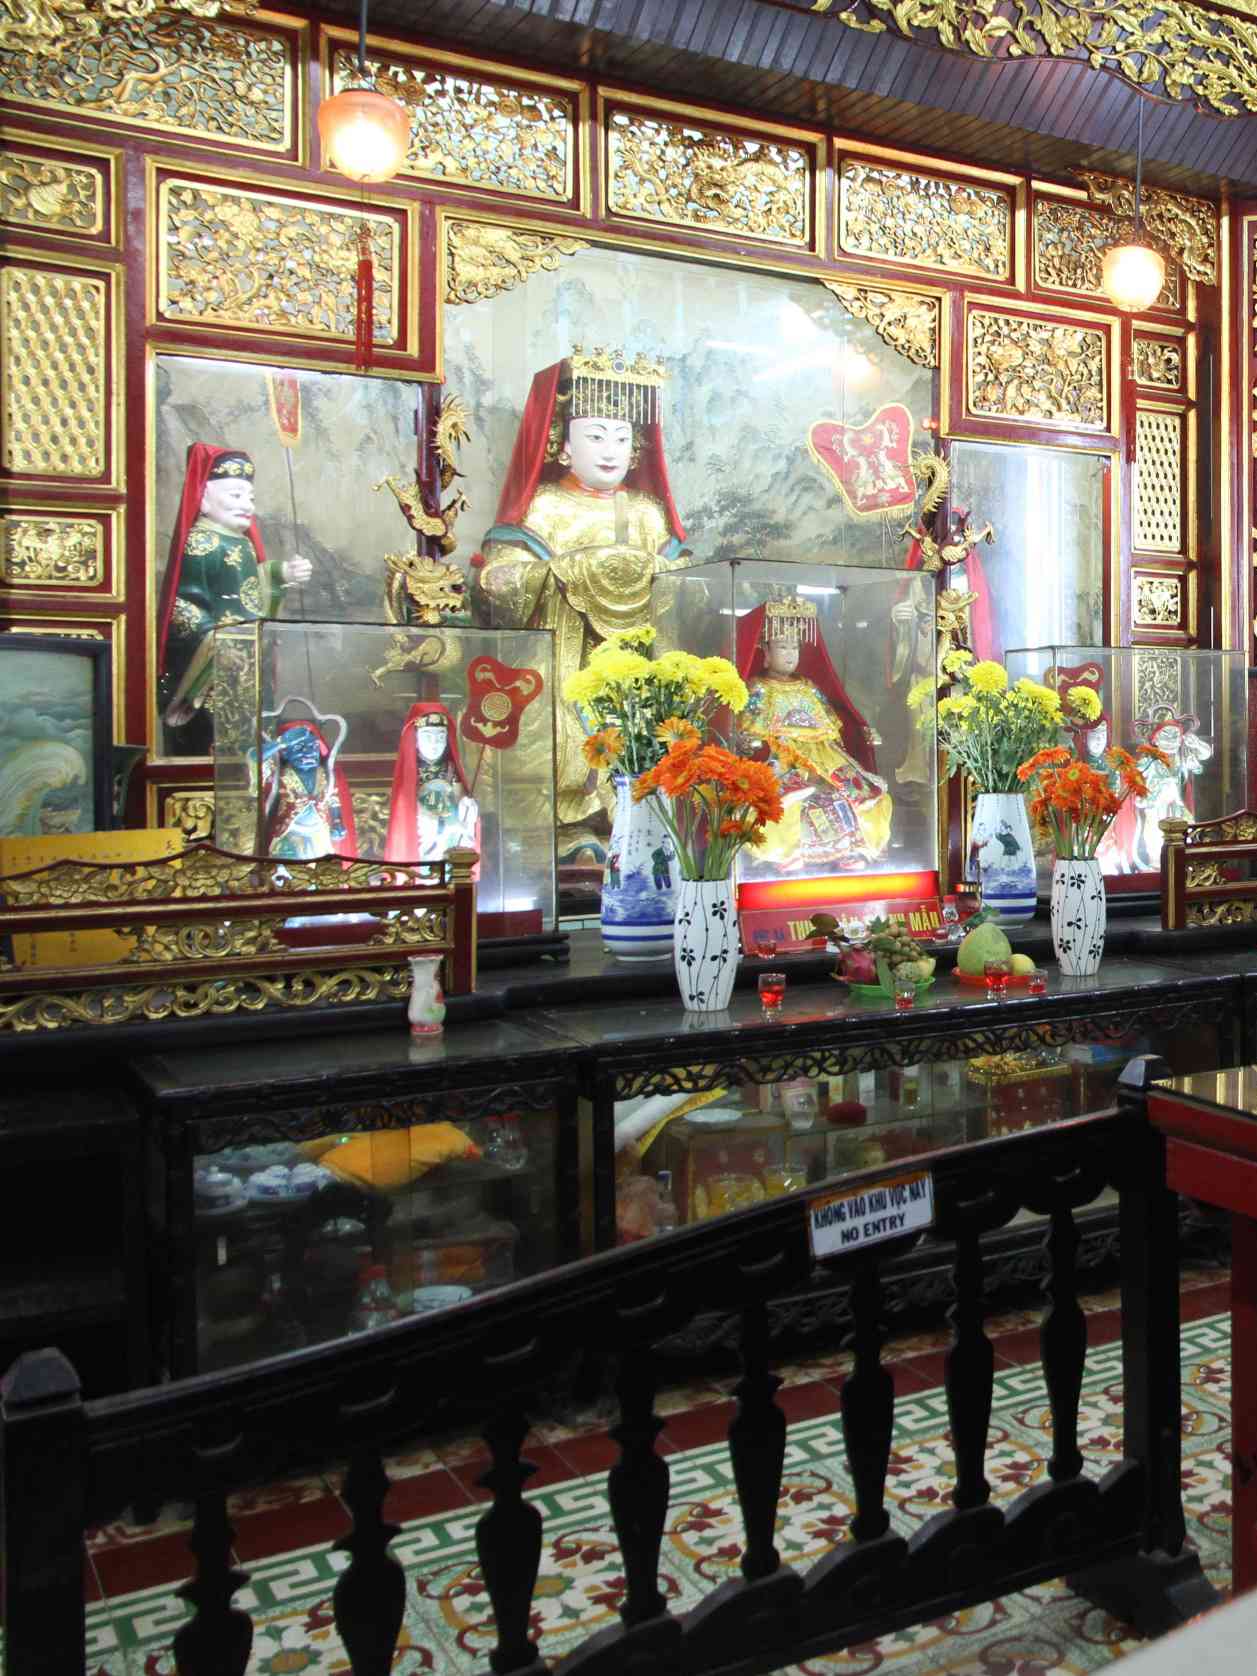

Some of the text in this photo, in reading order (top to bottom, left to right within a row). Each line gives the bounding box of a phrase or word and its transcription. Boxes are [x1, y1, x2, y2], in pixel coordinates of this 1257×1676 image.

[868, 1189, 888, 1213] KHU
[841, 1212, 905, 1245] NO ENTRY
